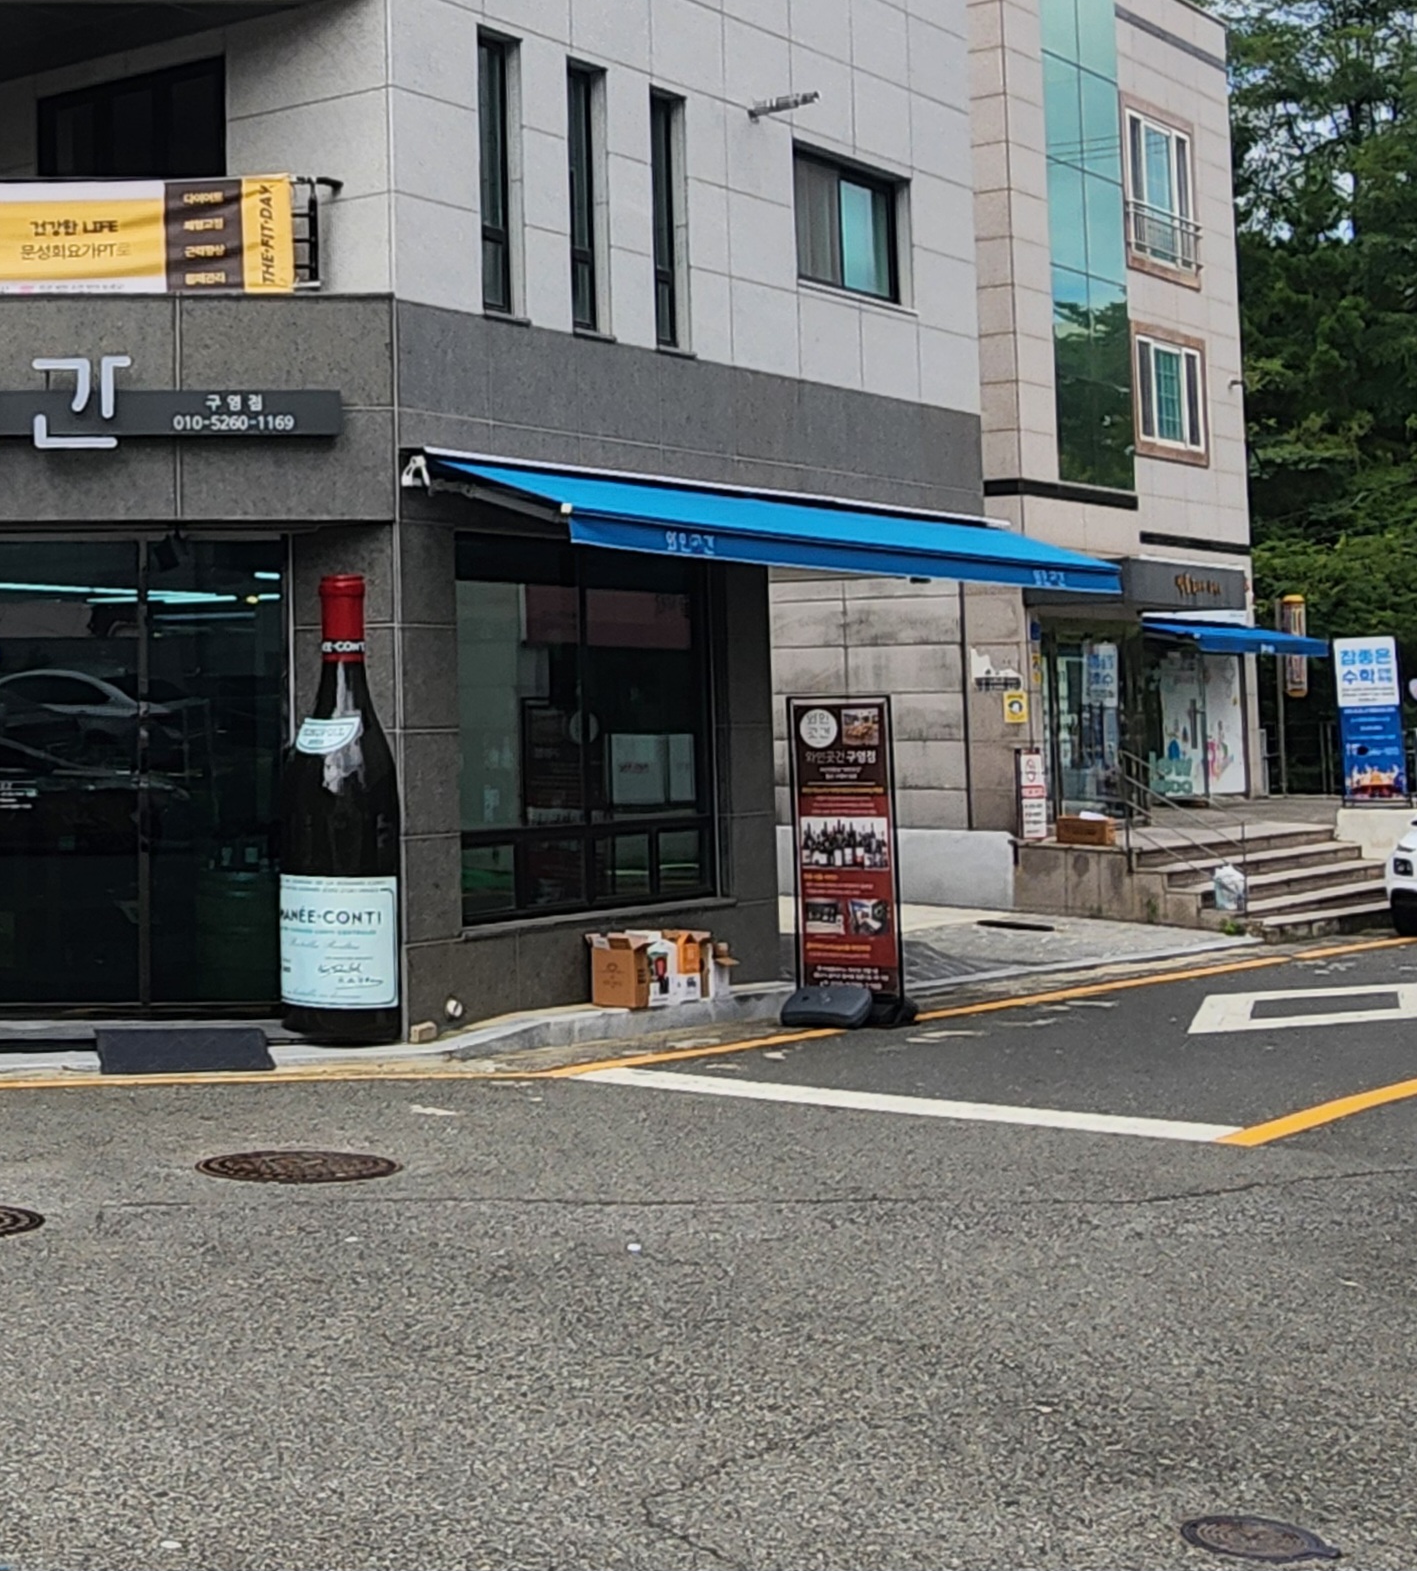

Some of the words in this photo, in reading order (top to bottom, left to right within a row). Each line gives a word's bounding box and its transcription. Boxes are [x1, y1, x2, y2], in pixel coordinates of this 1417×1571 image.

[30, 220, 78, 237] 건강한
[82, 220, 119, 233] LIFE
[205, 394, 262, 411] 구영점
[173, 414, 295, 430] 010-5260-1169
[1342, 669, 1375, 684] 수학
